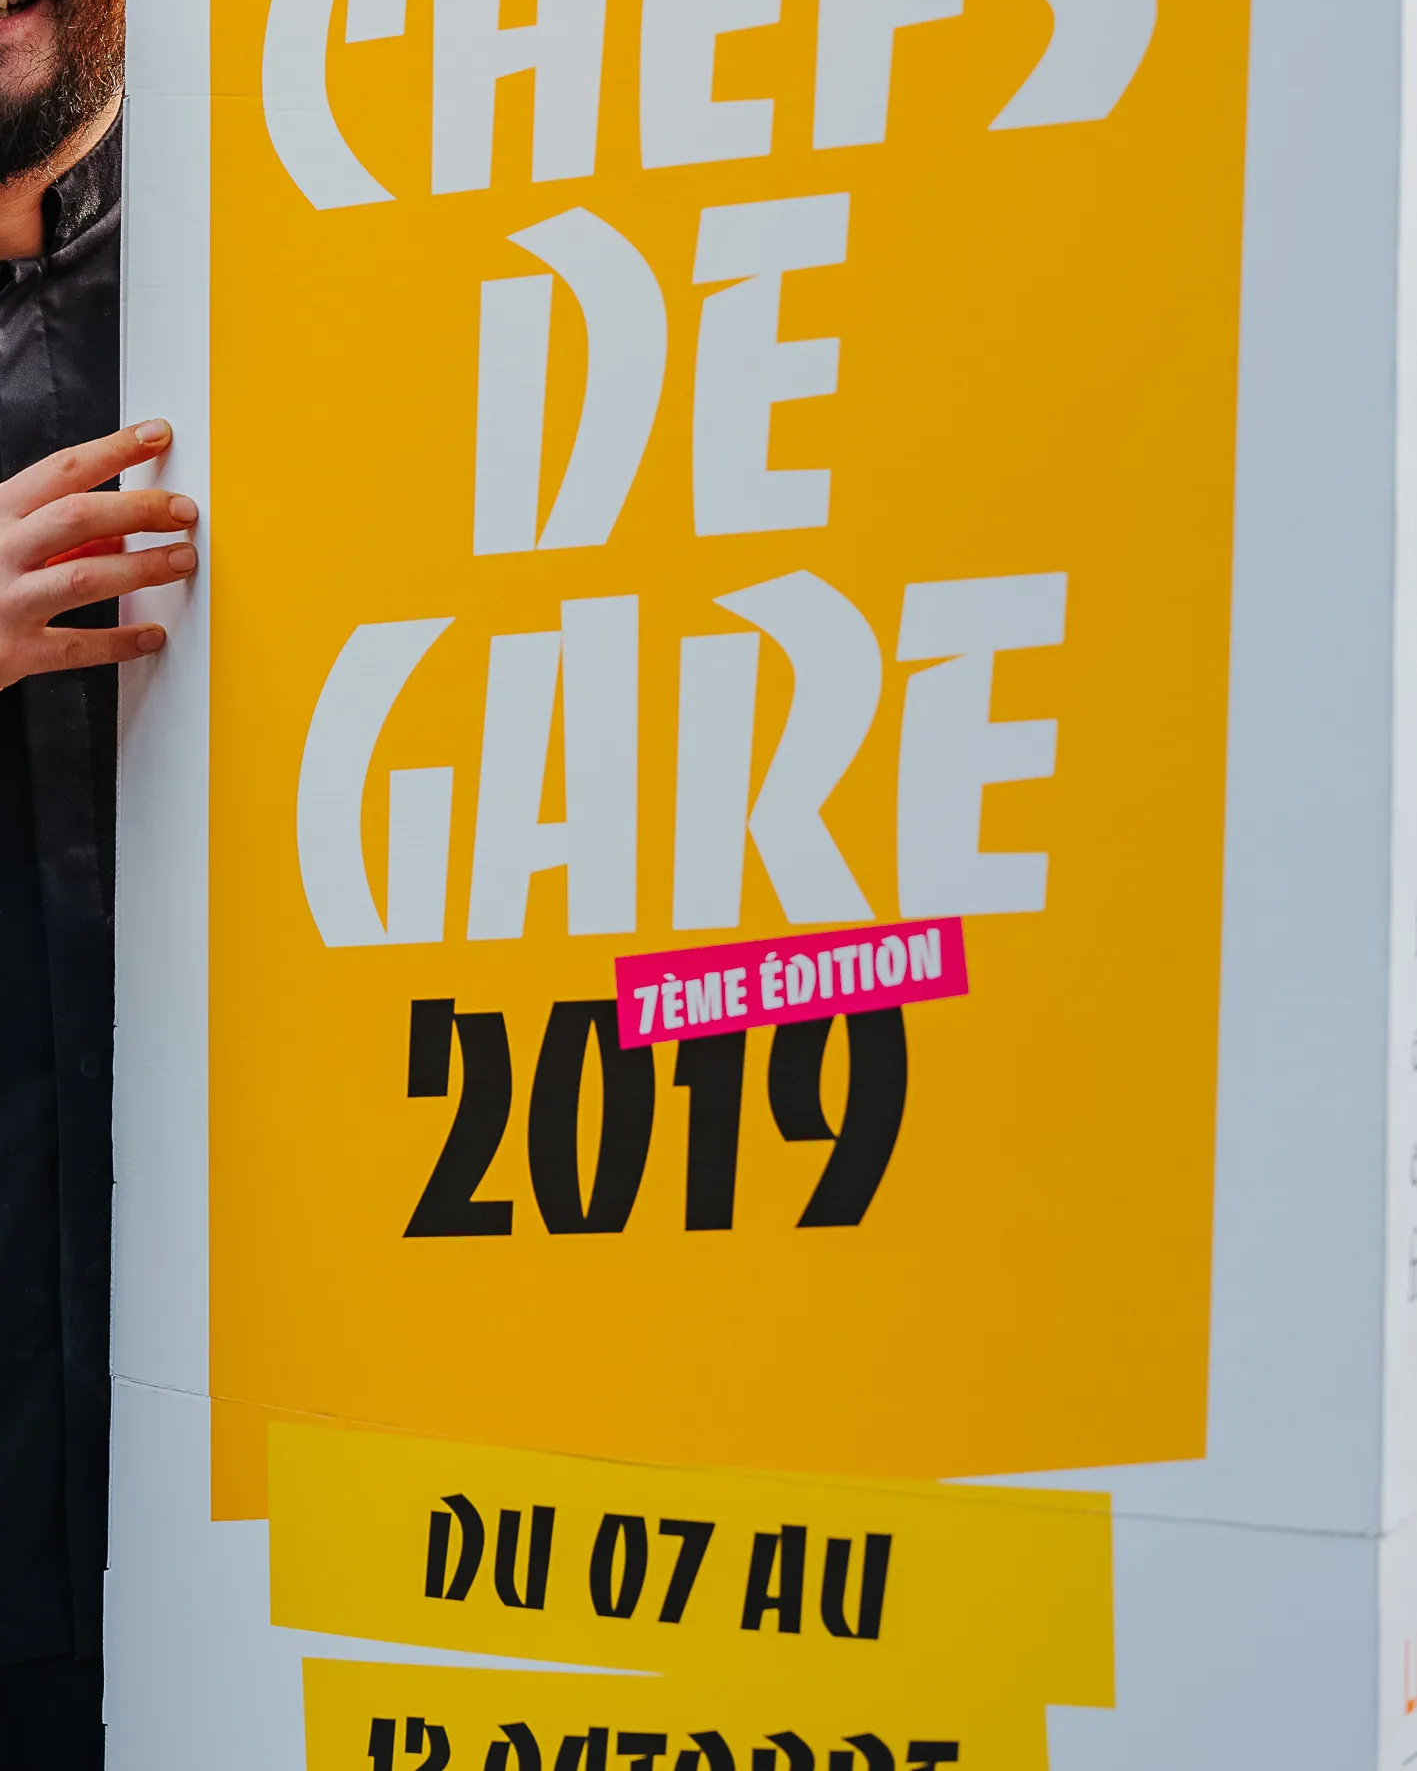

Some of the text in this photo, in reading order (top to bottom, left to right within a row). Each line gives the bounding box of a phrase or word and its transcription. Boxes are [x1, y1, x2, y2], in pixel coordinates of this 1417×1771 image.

[473, 191, 851, 556] DE
[296, 569, 1067, 948] GARE
[634, 928, 942, 1035] 7ÈME ÉDITION
[402, 998, 908, 1238] 2019
[425, 1493, 893, 1640] DU 07 AU
